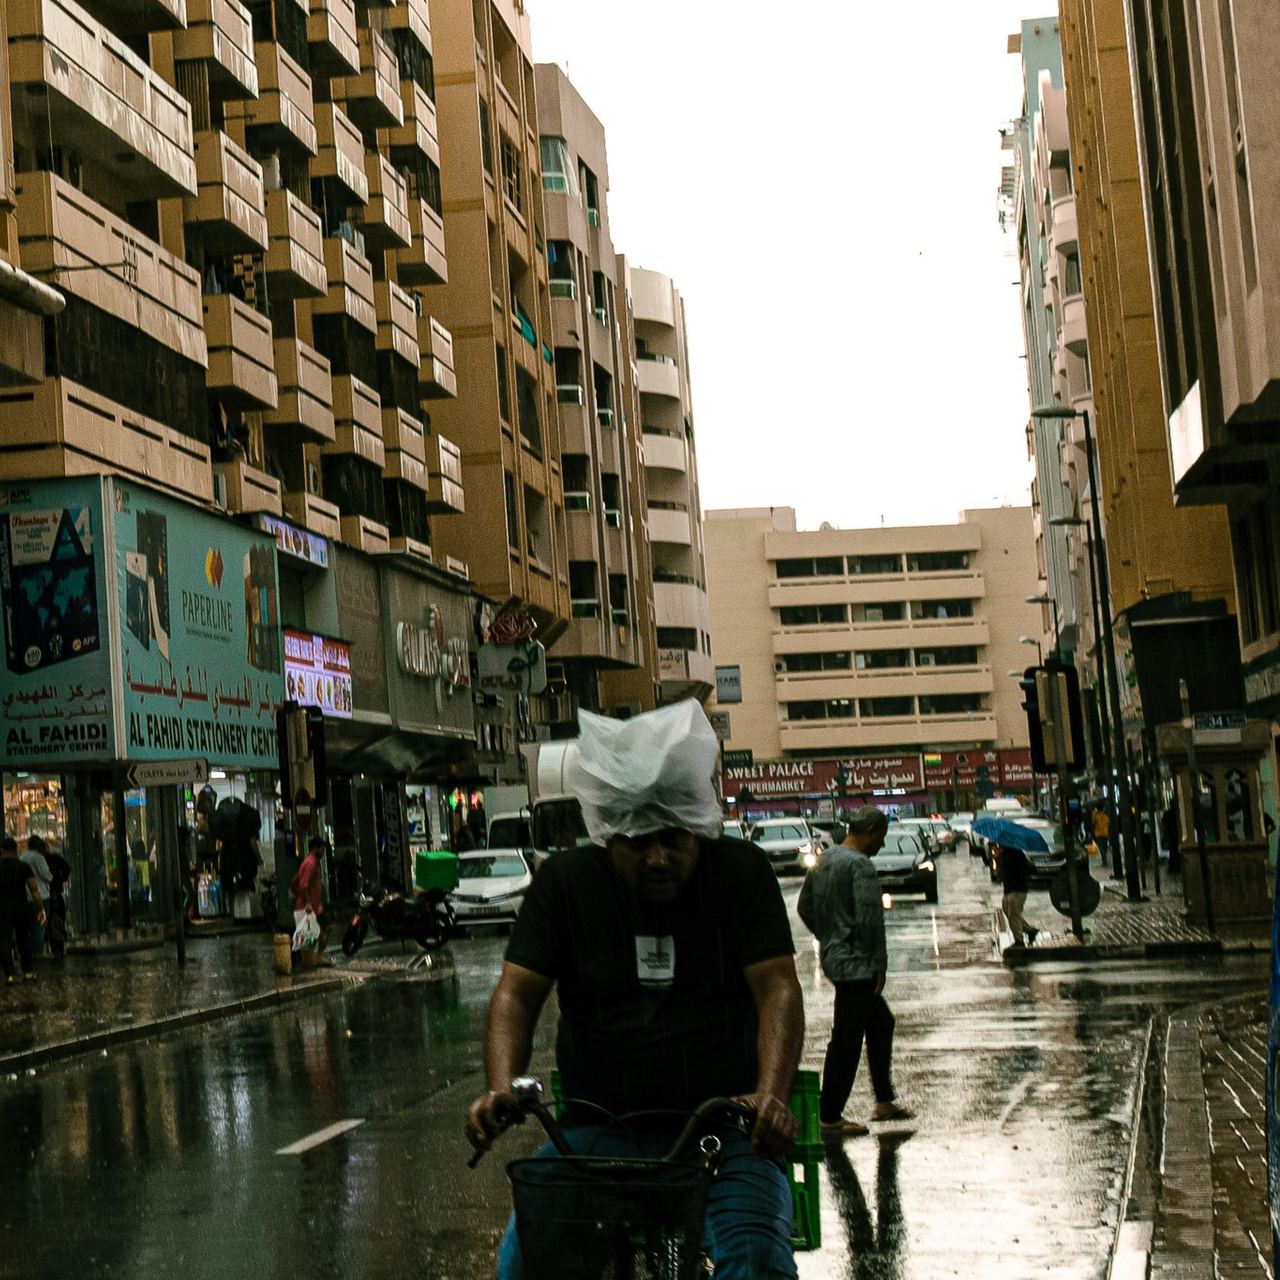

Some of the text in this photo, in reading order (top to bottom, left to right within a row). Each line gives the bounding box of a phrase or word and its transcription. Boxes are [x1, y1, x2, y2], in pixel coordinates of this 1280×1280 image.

[181, 589, 233, 633] PAPERLINE
[66, 685, 106, 702] مركز
[6, 723, 107, 745] AL FAHIDI
[129, 712, 145, 747] AL
[146, 715, 185, 751] FAHIDI
[186, 718, 249, 756] STATIONERY
[6, 740, 108, 757] STATIONERY CENTRE
[727, 761, 815, 780] SWEET PALACE
[869, 772, 915, 788] سويت
